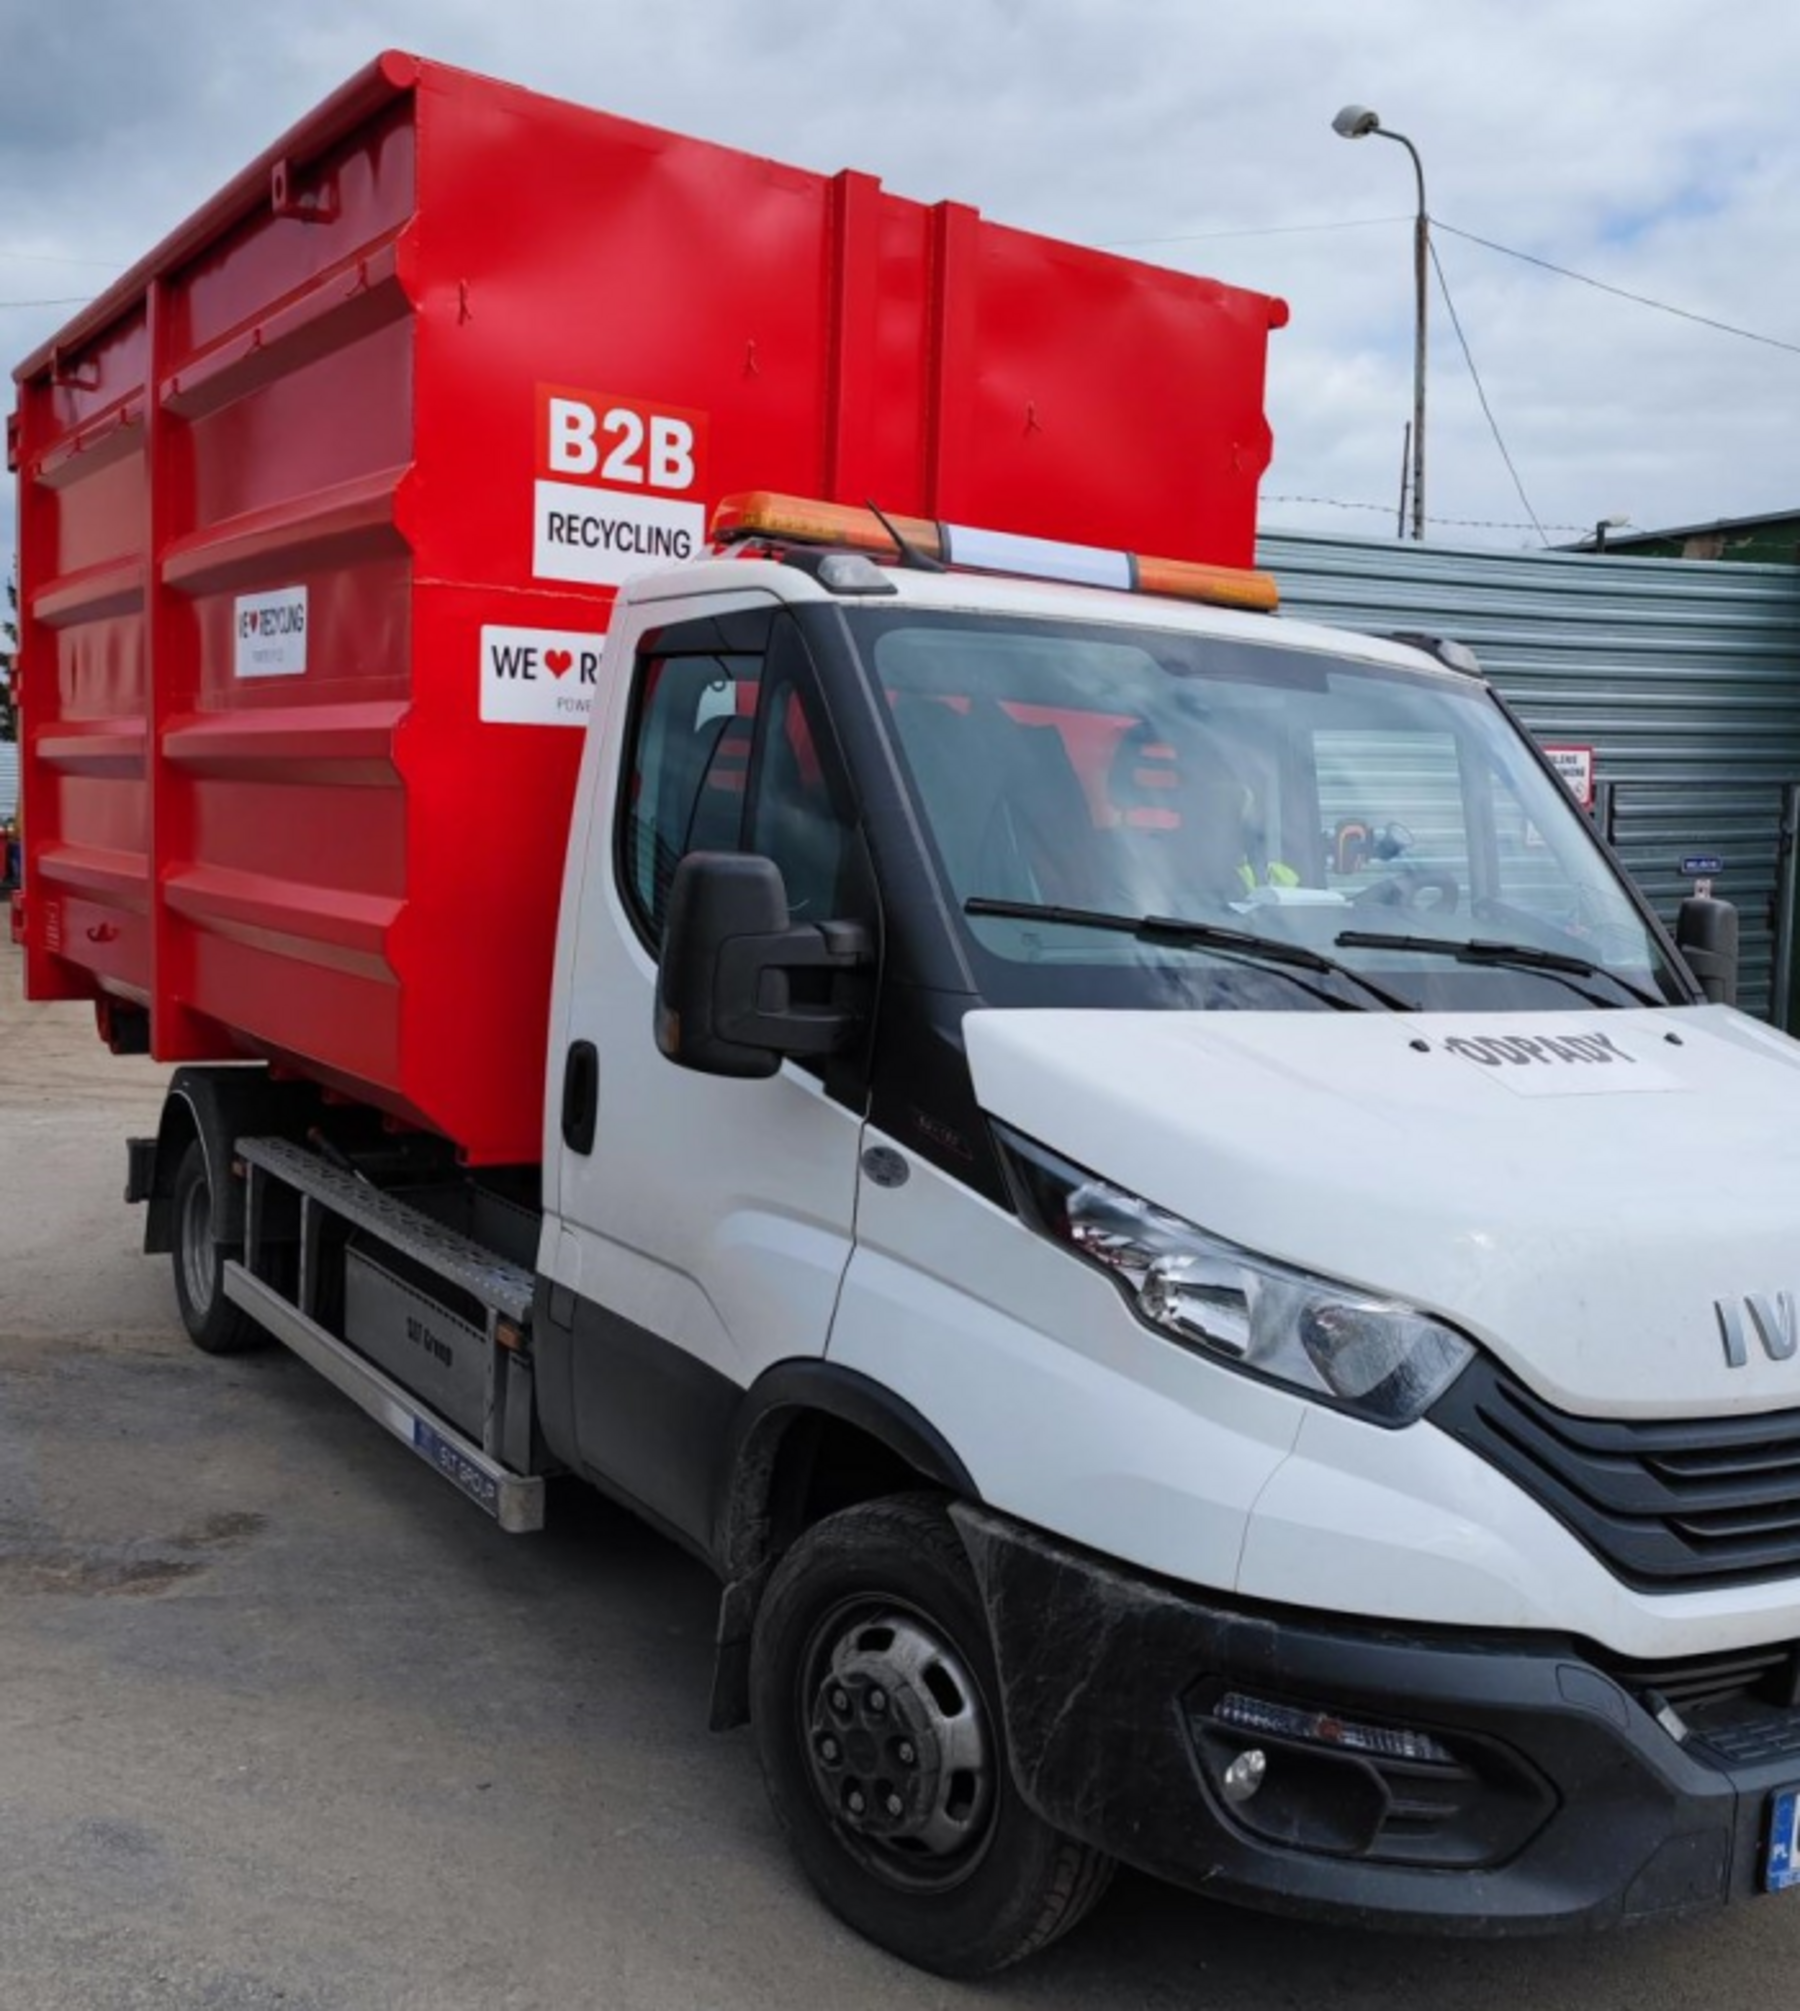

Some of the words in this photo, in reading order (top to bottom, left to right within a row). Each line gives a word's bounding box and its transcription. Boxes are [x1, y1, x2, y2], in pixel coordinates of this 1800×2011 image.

[548, 397, 695, 490] B2B
[548, 511, 692, 559] RECYCLING
[491, 645, 538, 680] WE
[580, 652, 603, 684] R
[1444, 1032, 1636, 1066] ODPADY
[1713, 1291, 1798, 1368] IV
